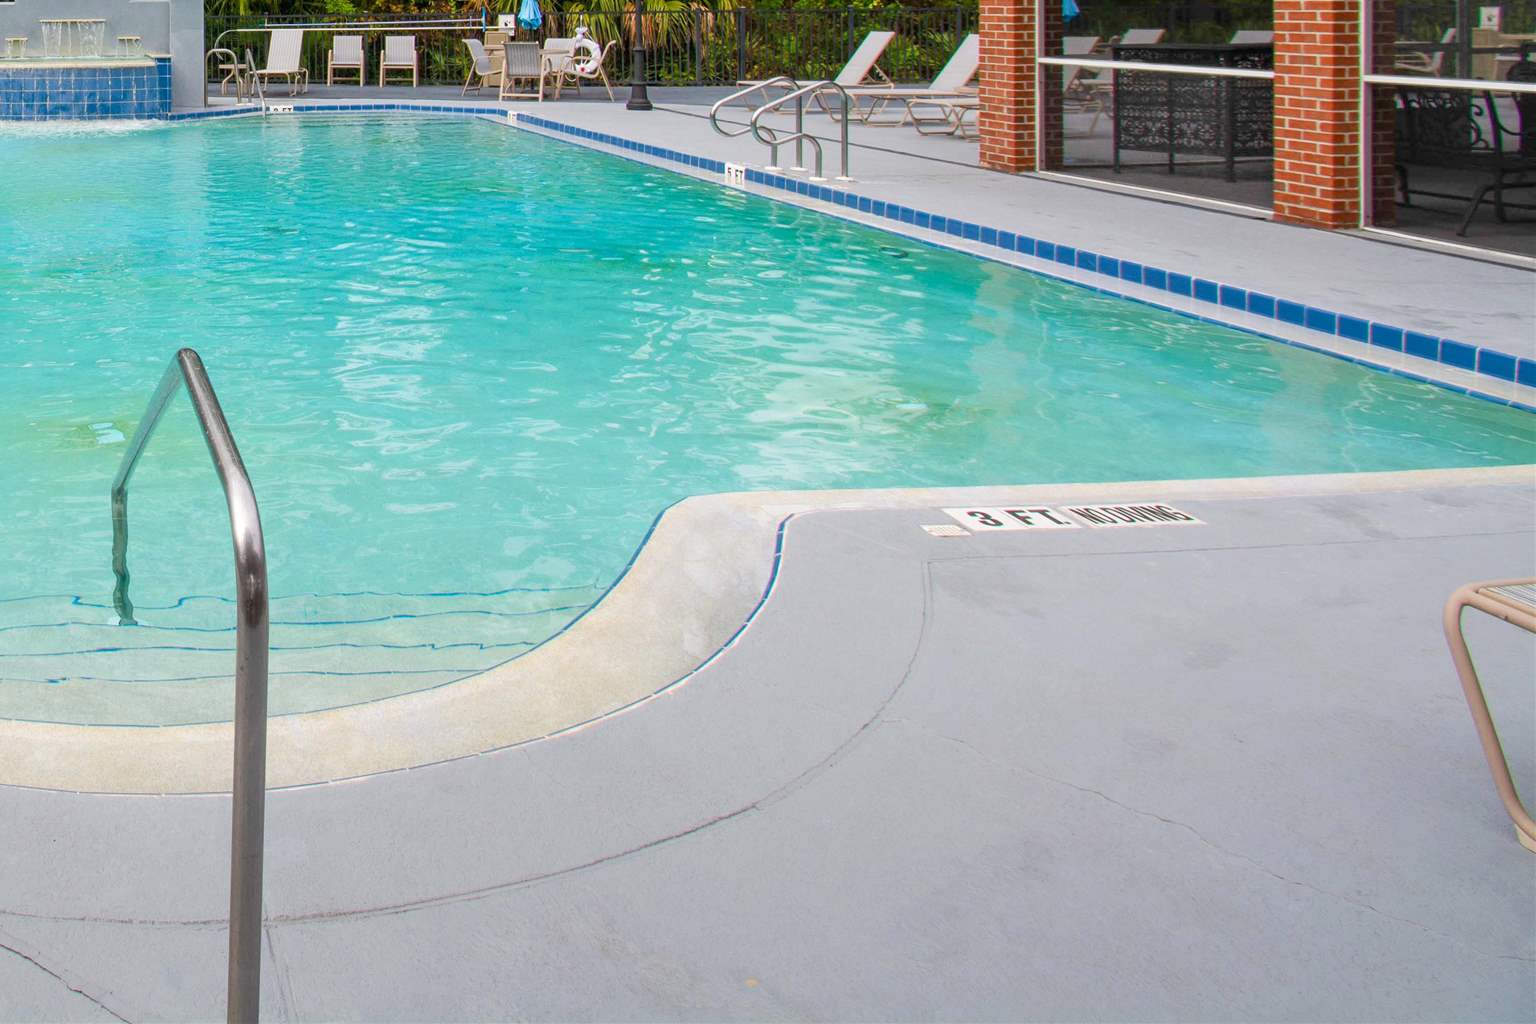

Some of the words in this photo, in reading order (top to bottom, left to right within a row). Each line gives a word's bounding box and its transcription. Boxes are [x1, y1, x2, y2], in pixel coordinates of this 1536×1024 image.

[735, 168, 744, 178] FT
[966, 511, 1003, 527] 3
[1068, 508, 1117, 524] NO
[1098, 505, 1195, 523] DIVING
